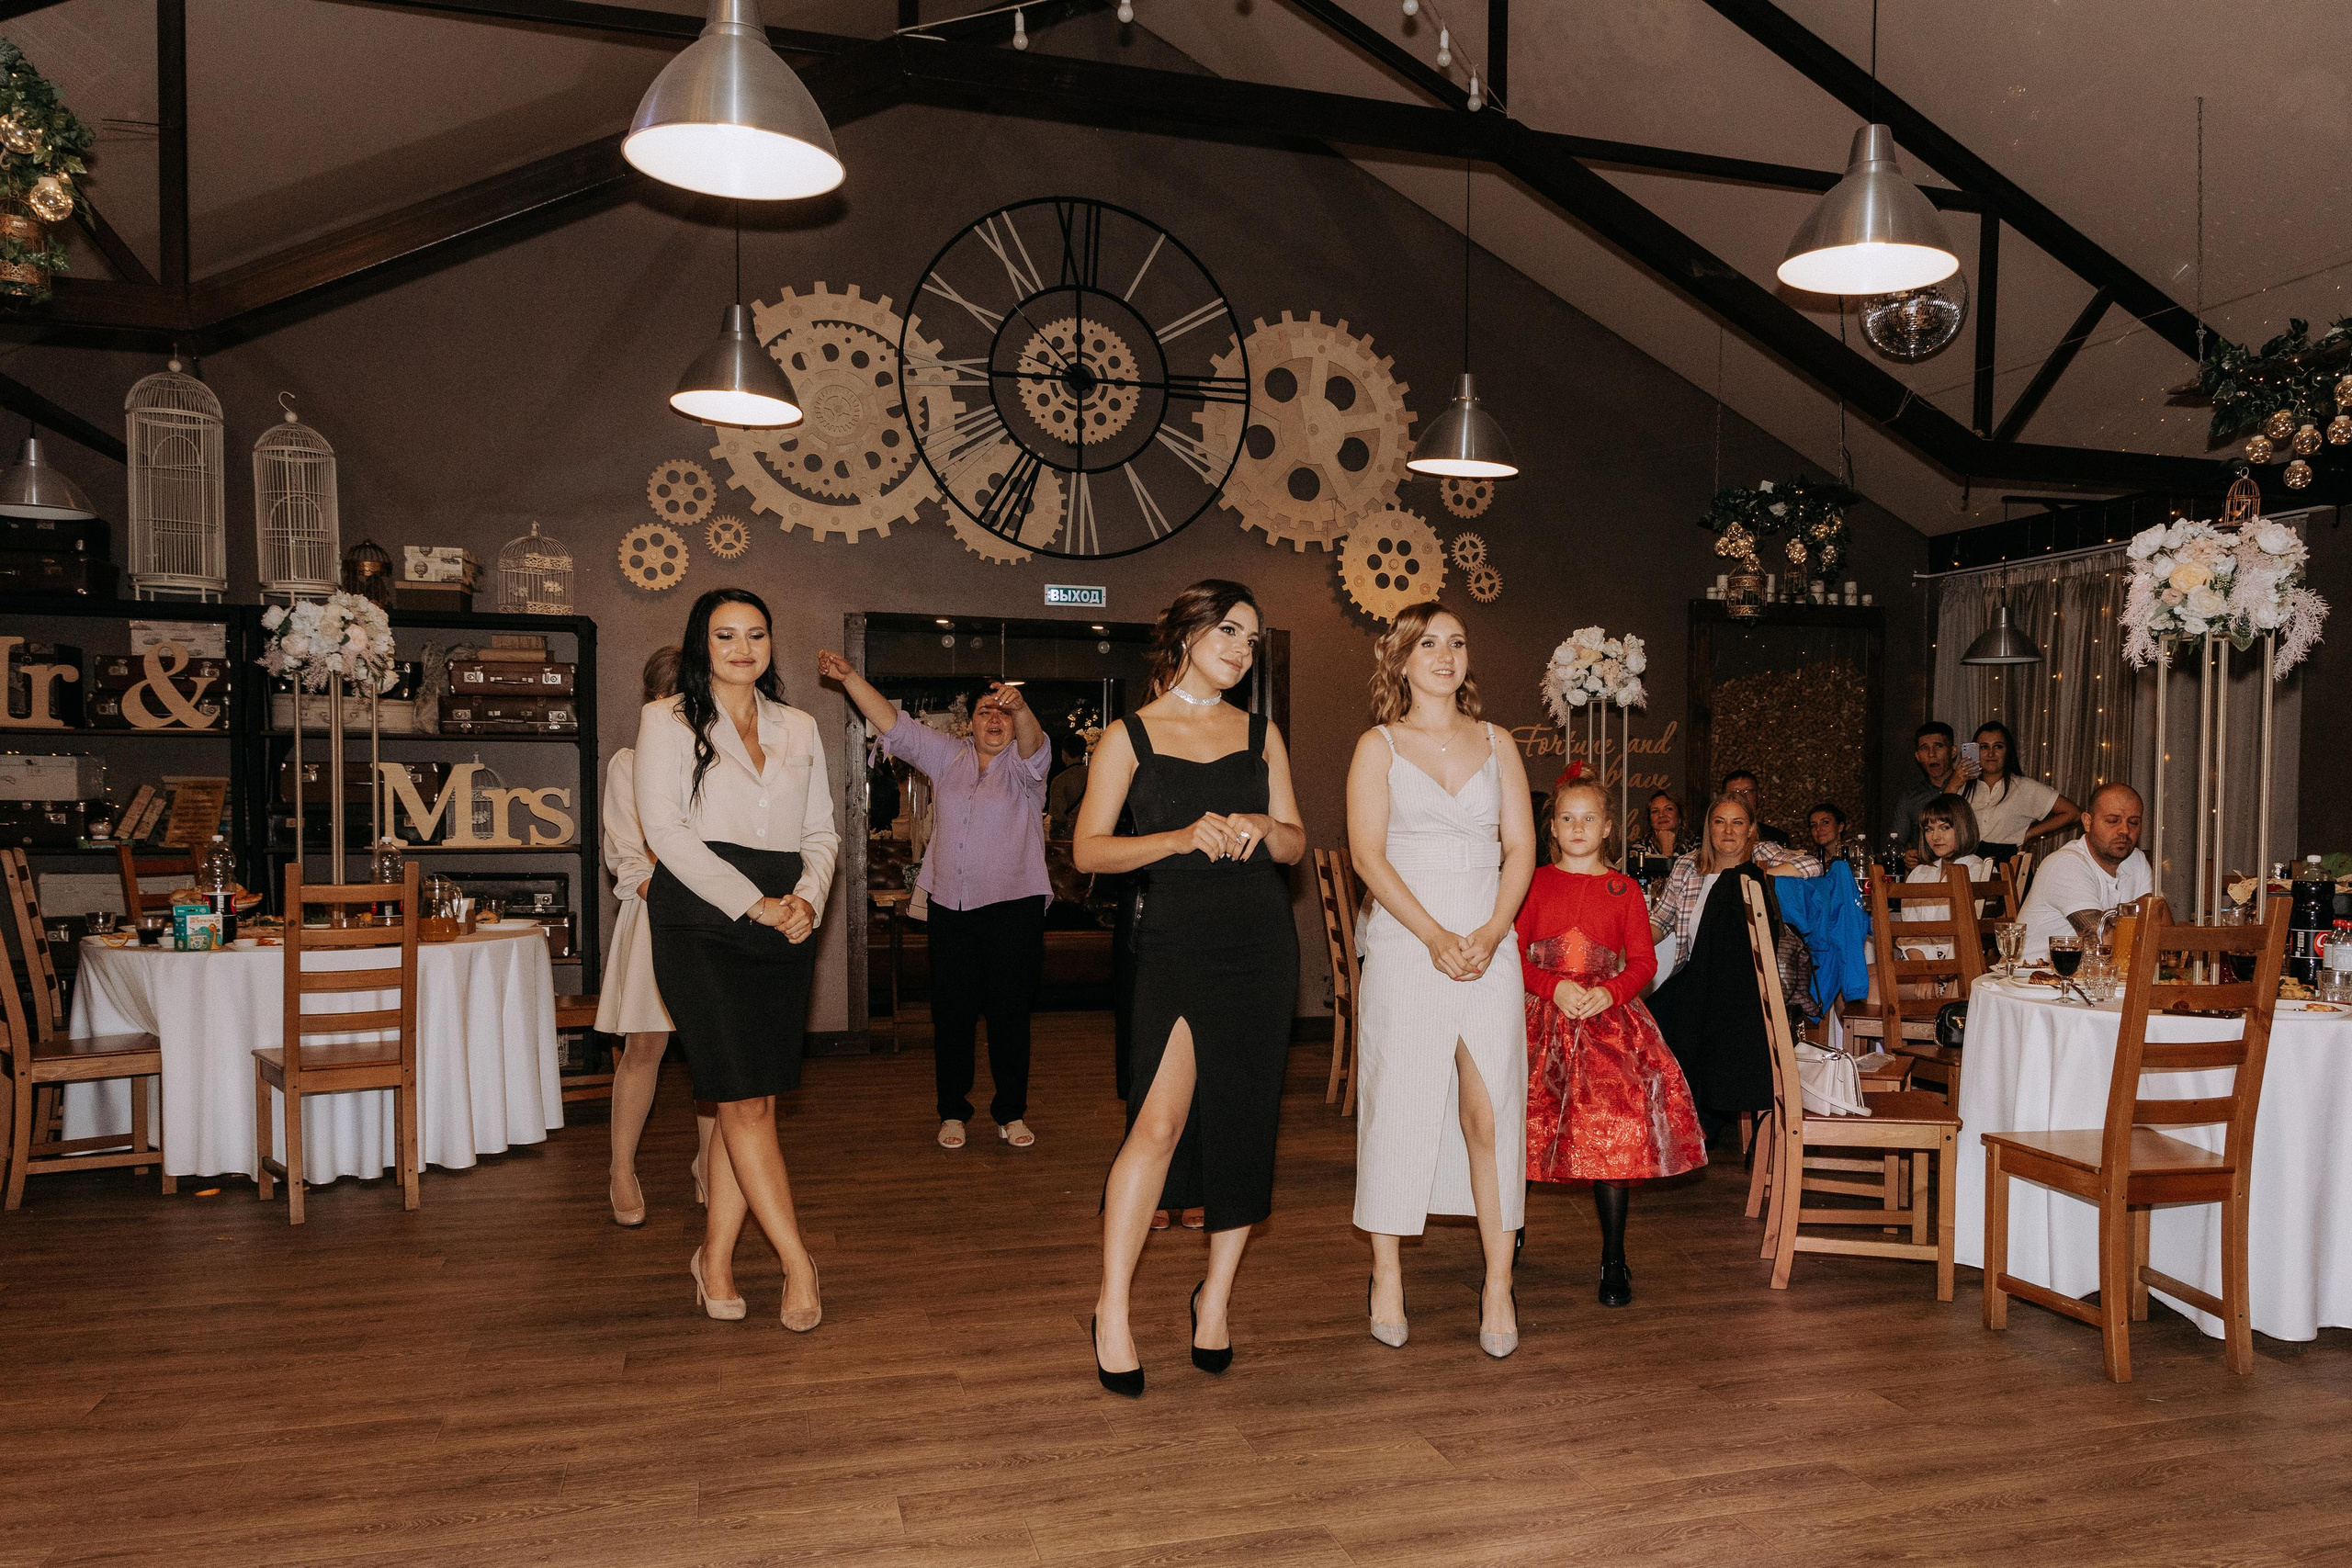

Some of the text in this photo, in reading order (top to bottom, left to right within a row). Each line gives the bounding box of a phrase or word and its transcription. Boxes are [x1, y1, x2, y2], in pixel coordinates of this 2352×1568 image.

[974, 210, 1045, 302] XI
[1056, 200, 1101, 288] XII
[1124, 232, 1167, 302] I
[922, 271, 1004, 334] X
[1155, 297, 1228, 344] II
[1168, 375, 1247, 404] III
[978, 448, 1042, 542] VII
[1065, 472, 1100, 555] VI
[1124, 462, 1173, 539] V
[1050, 588, 1100, 604] ВЫХОД
[121, 642, 220, 728] &
[1510, 720, 1678, 758] Fortune and
[369, 761, 575, 846] Mrs
